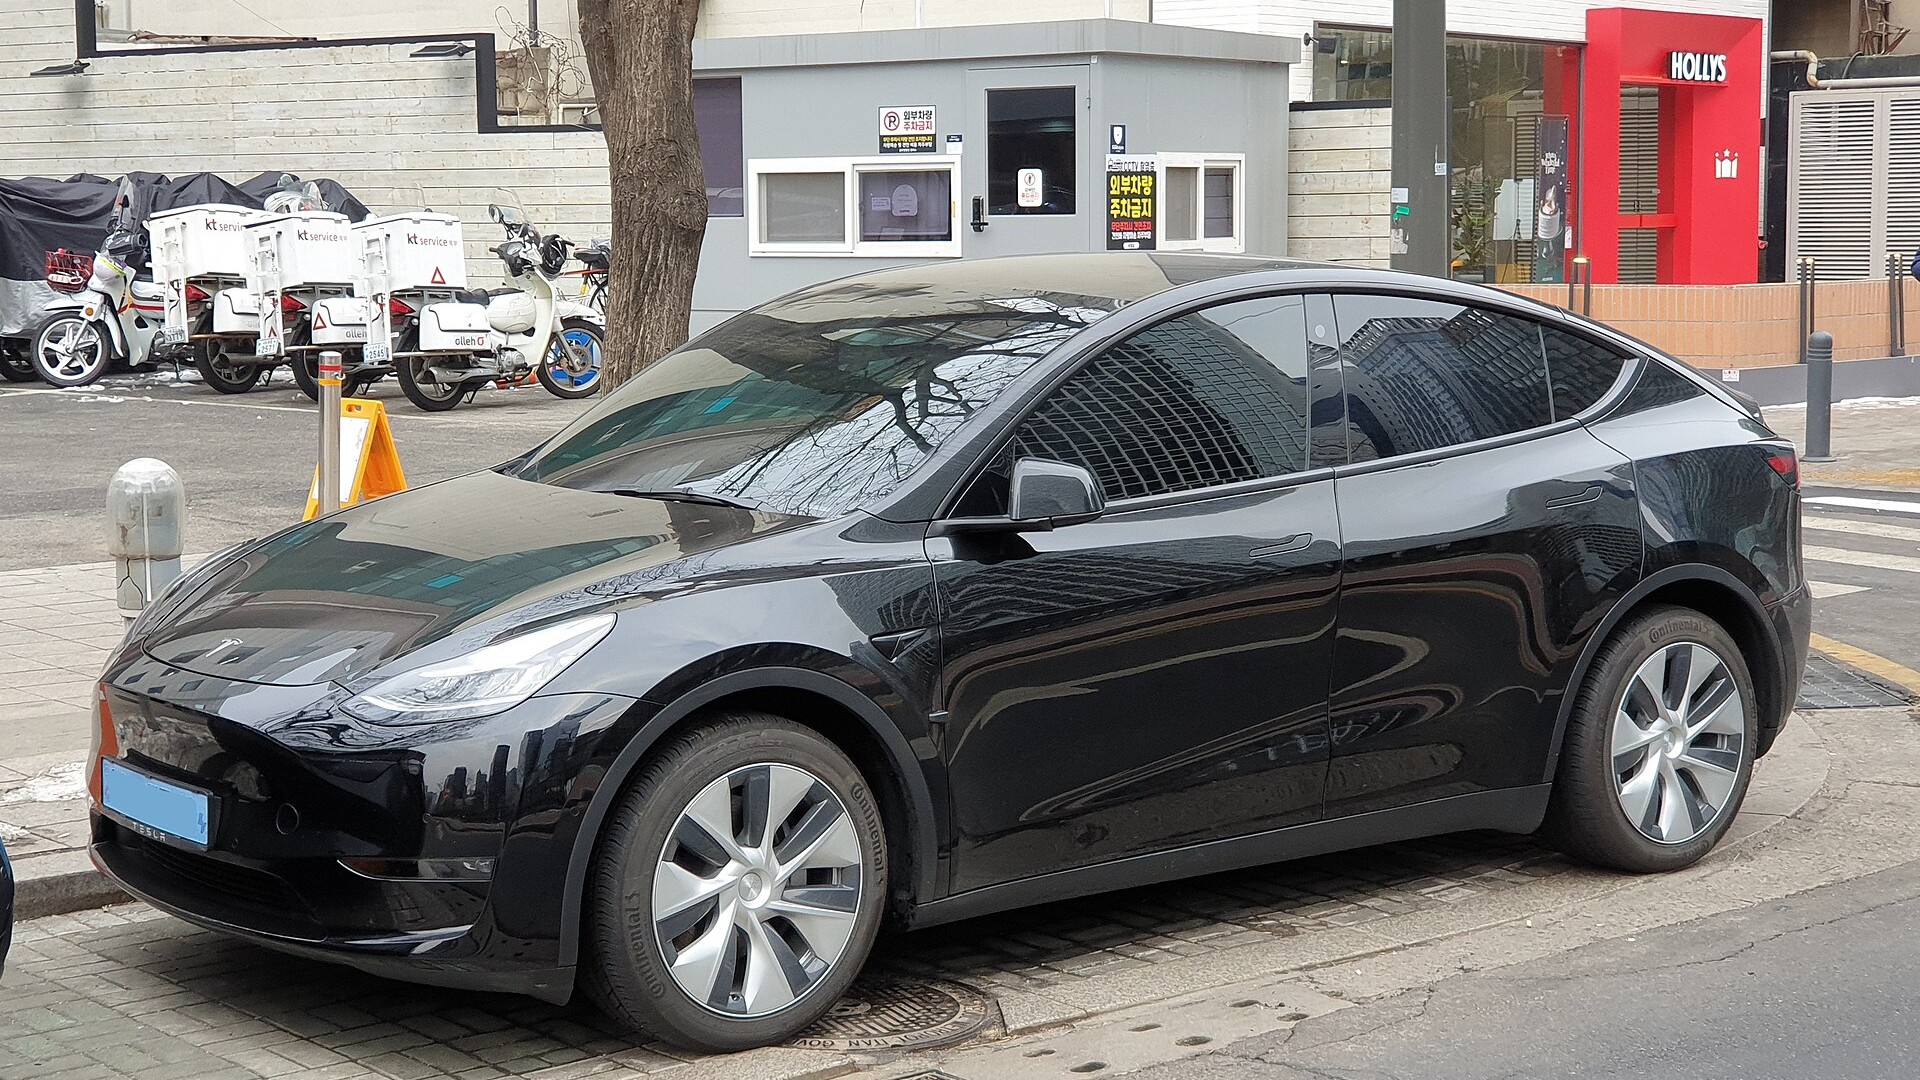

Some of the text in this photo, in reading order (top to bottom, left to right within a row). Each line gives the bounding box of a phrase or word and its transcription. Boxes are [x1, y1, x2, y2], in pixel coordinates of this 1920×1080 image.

[1671, 51, 1727, 82] HOLLYS
[903, 110, 933, 120] 외부차량
[903, 121, 933, 131] 주차금지
[1123, 161, 1139, 171] CCTV
[1110, 174, 1153, 196] 외부차량
[1110, 197, 1152, 219] 주차금지
[205, 218, 244, 232] kt servi
[297, 229, 309, 241] kt
[310, 232, 338, 242] service
[407, 233, 418, 245] kt
[420, 236, 448, 247] service
[455, 335, 476, 346] olleh
[369, 349, 385, 359] 2545
[1649, 620, 1702, 643] Continental
[132, 821, 167, 842] TESLA
[850, 781, 885, 872] Continental
[624, 906, 666, 1000] Continental
